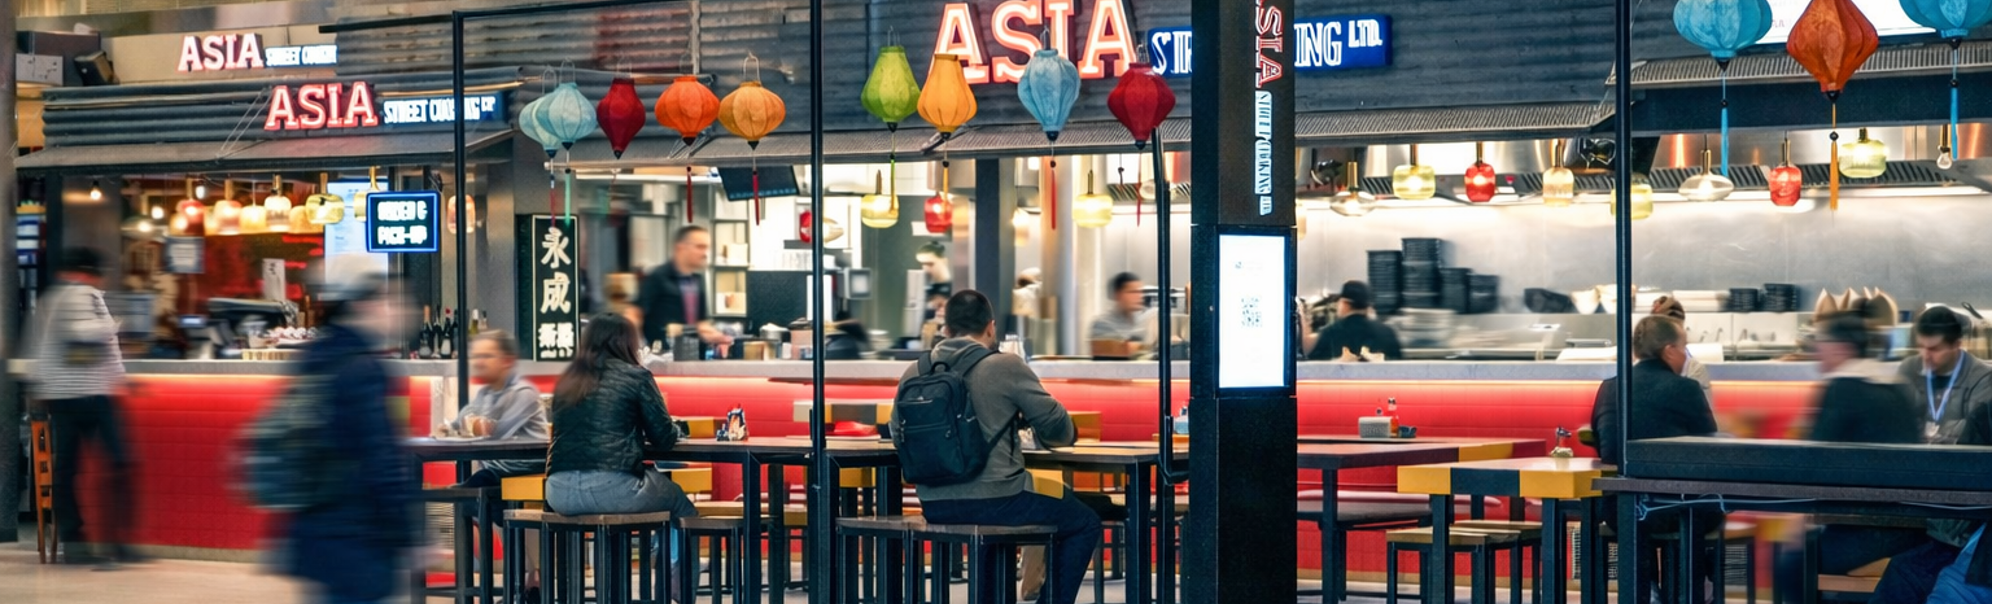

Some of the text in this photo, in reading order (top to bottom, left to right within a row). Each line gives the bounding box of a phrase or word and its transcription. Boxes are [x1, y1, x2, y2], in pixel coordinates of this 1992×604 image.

[177, 32, 264, 72] ASIA
[928, 0, 1139, 84] ASIA
[1255, 0, 1283, 89] SIA
[263, 81, 379, 131] ASIA
